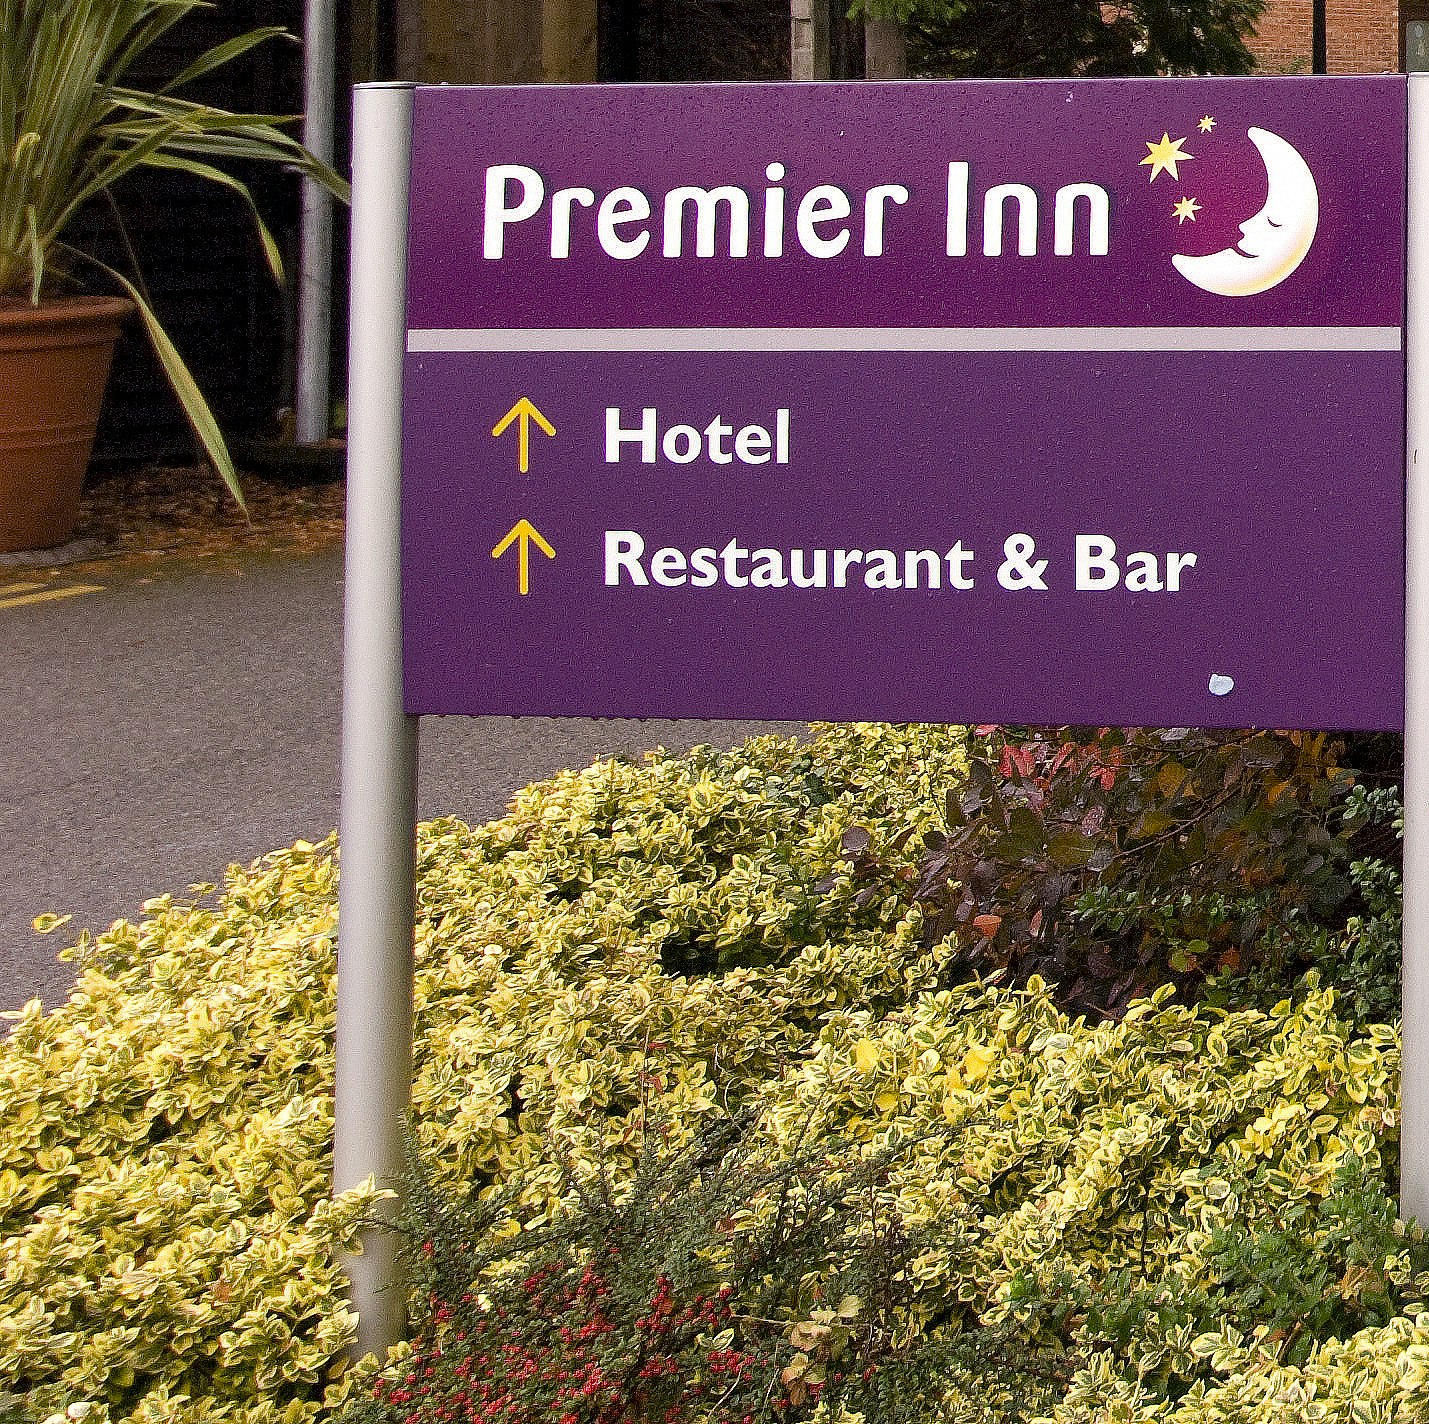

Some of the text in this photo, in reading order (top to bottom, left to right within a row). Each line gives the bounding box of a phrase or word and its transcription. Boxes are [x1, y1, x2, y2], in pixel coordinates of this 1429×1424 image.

[482, 160, 1110, 261] Premier Inn
[604, 406, 791, 466] Hotel
[603, 529, 1199, 594] Restaurant & Bar
